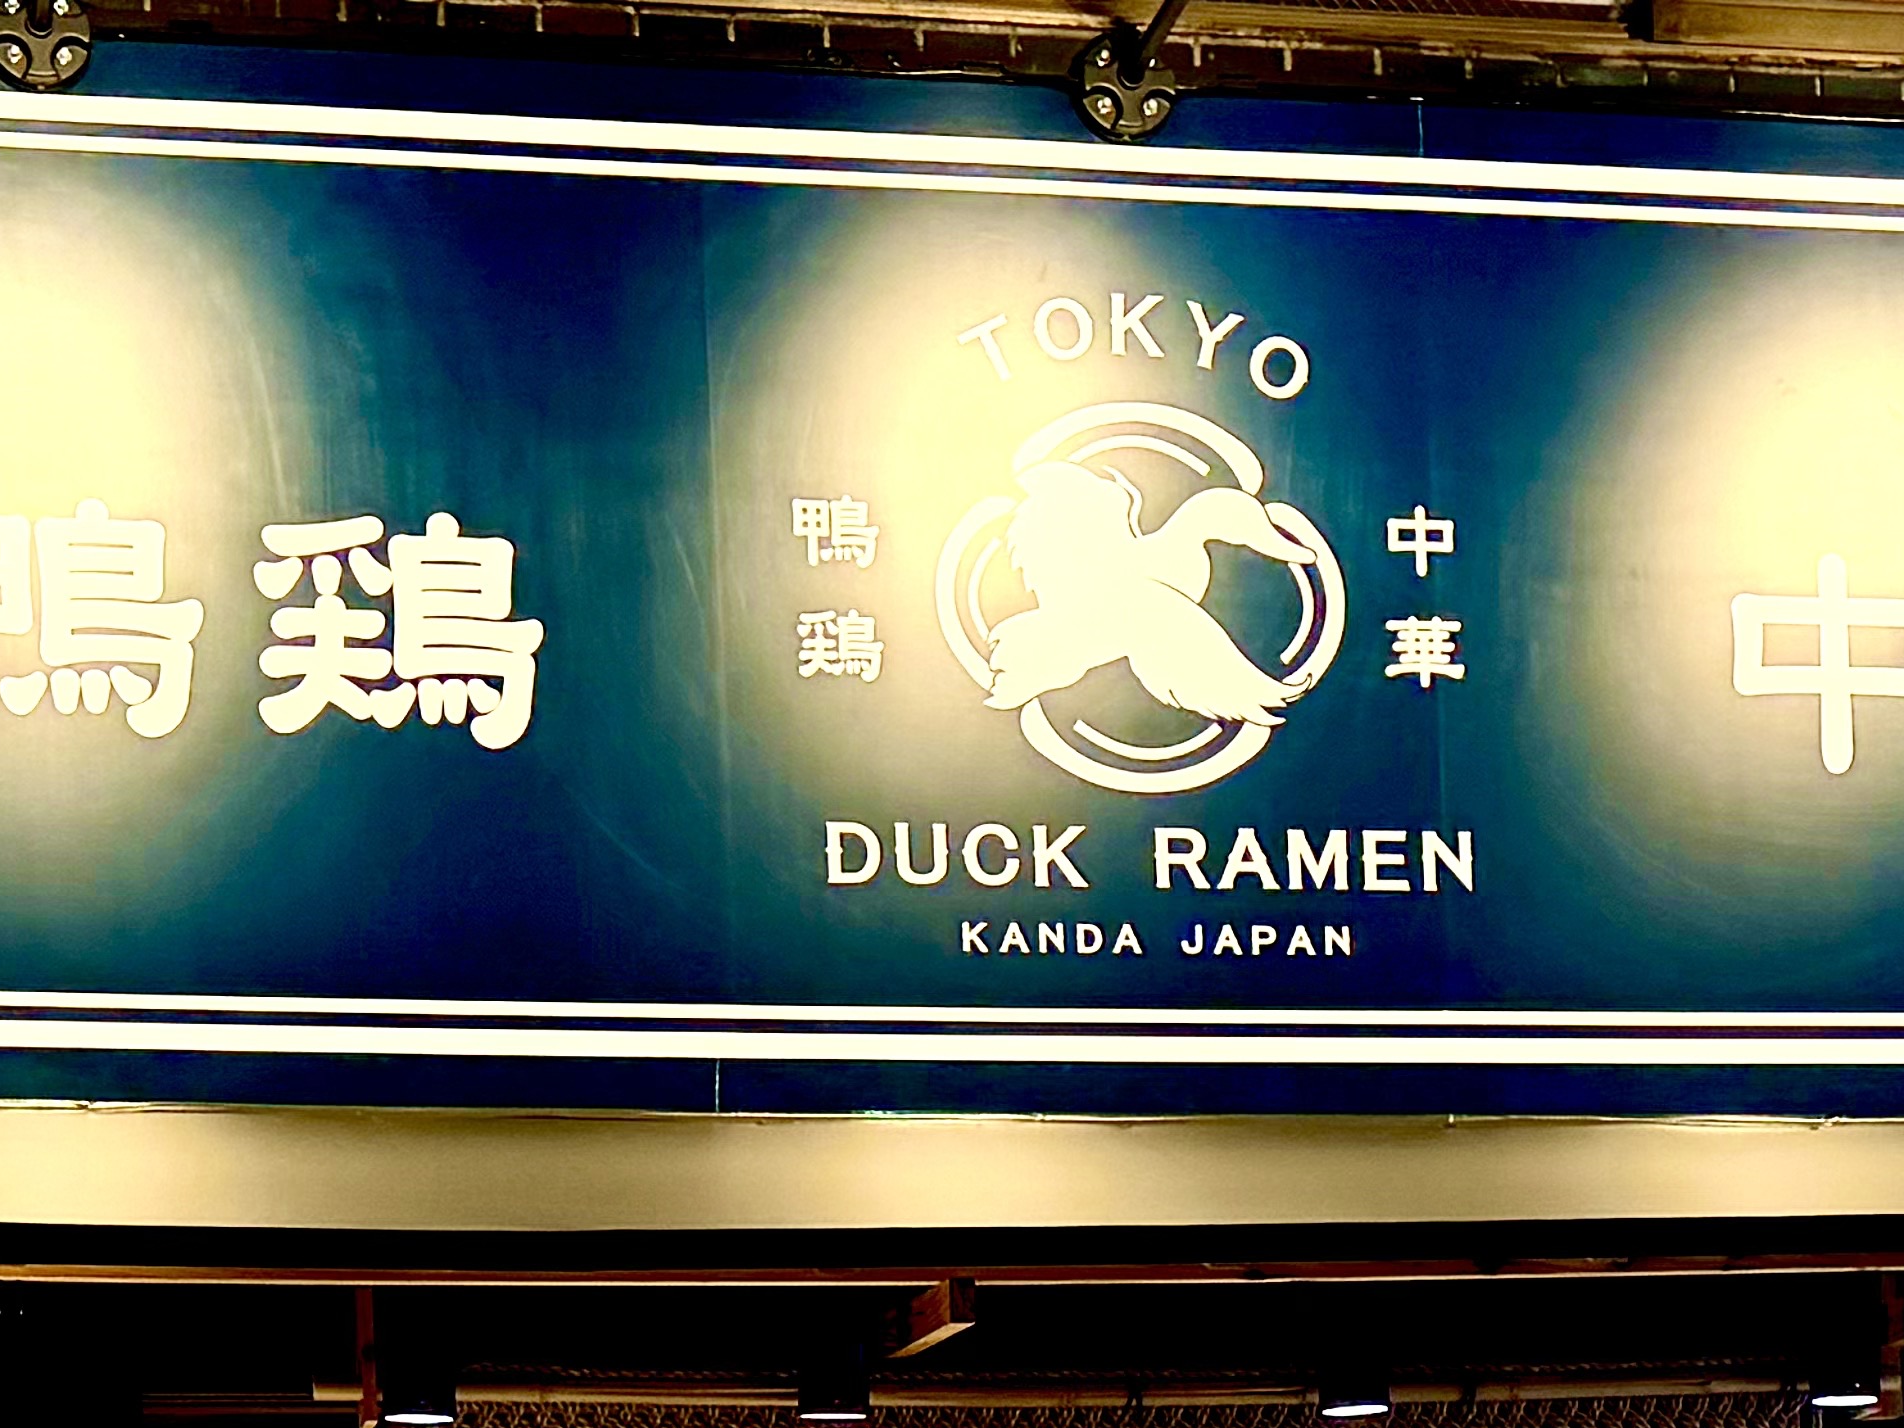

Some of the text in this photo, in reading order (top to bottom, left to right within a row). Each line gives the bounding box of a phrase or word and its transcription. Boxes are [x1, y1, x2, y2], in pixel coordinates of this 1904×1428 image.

[957, 292, 1310, 400] TOKYO
[1385, 504, 1467, 689] 中華
[823, 820, 1477, 893] DUCK RAMEN
[960, 920, 1353, 957] KANDA JAPAN
